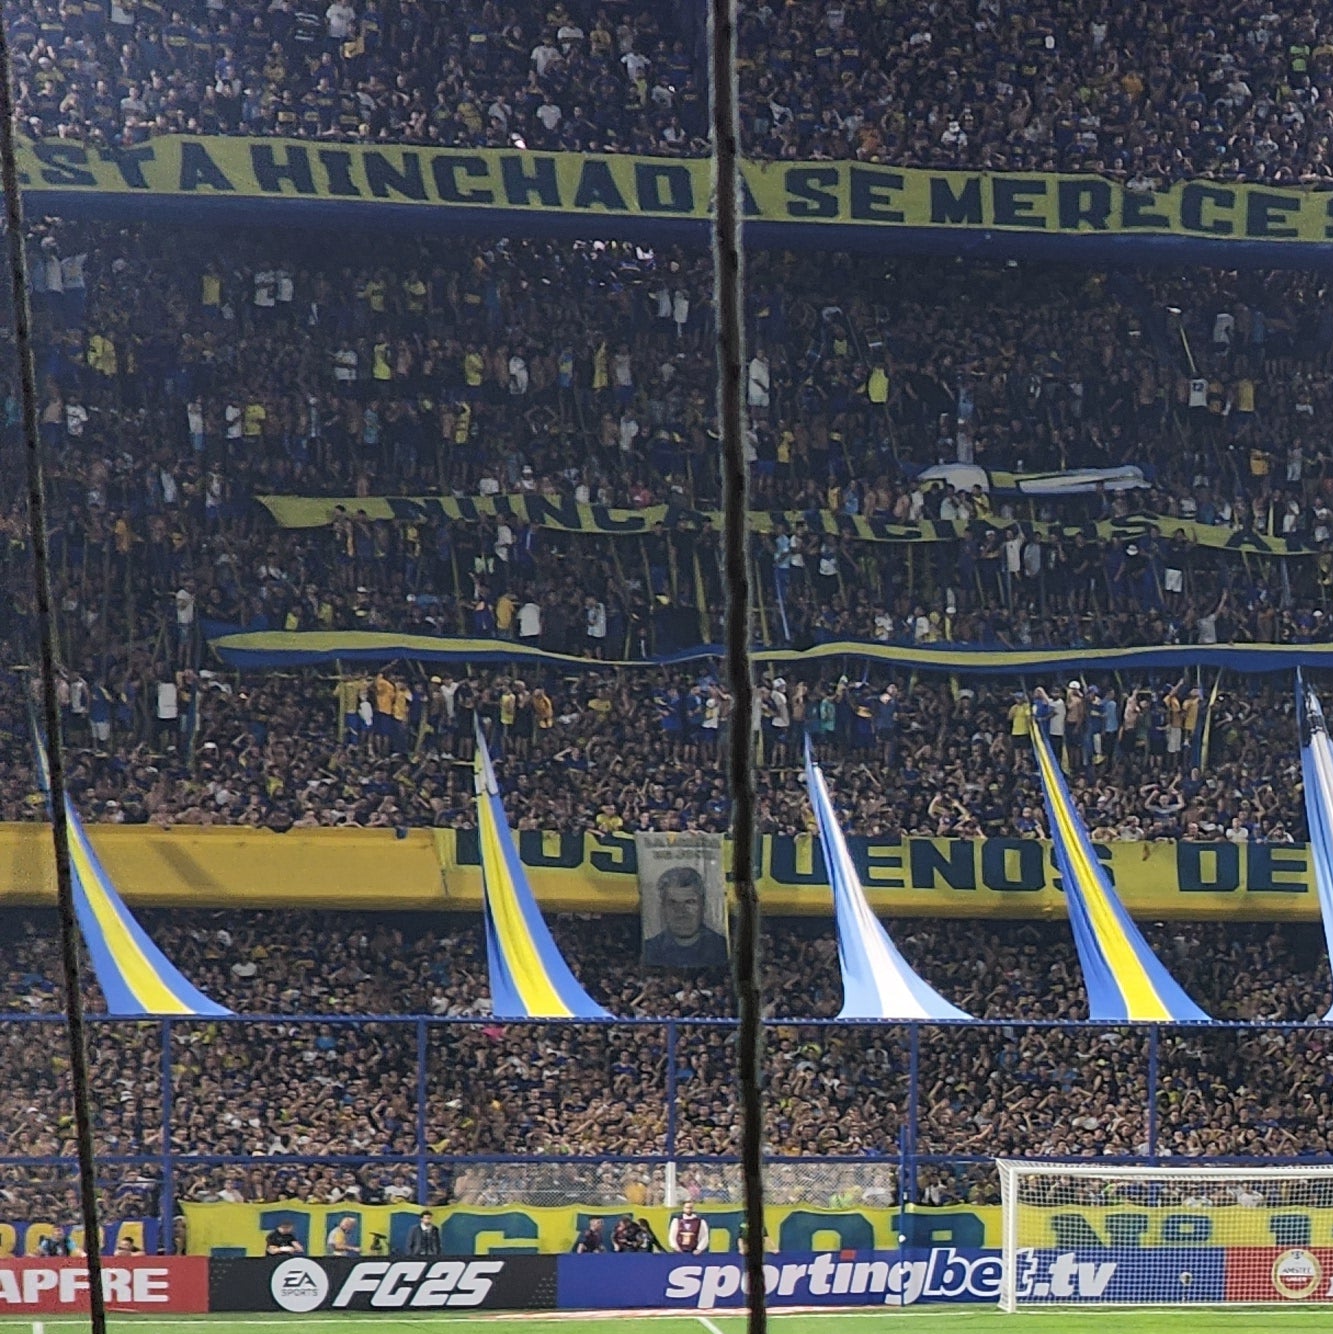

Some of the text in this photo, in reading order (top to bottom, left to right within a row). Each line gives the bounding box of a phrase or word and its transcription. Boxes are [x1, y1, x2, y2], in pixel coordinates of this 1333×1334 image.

[18, 142, 235, 190] STA
[786, 167, 906, 221] SE
[930, 177, 1301, 238] MERECE
[1177, 842, 1310, 893] DE
[279, 1289, 317, 1297] SPORTS
[282, 1271, 315, 1287] EA
